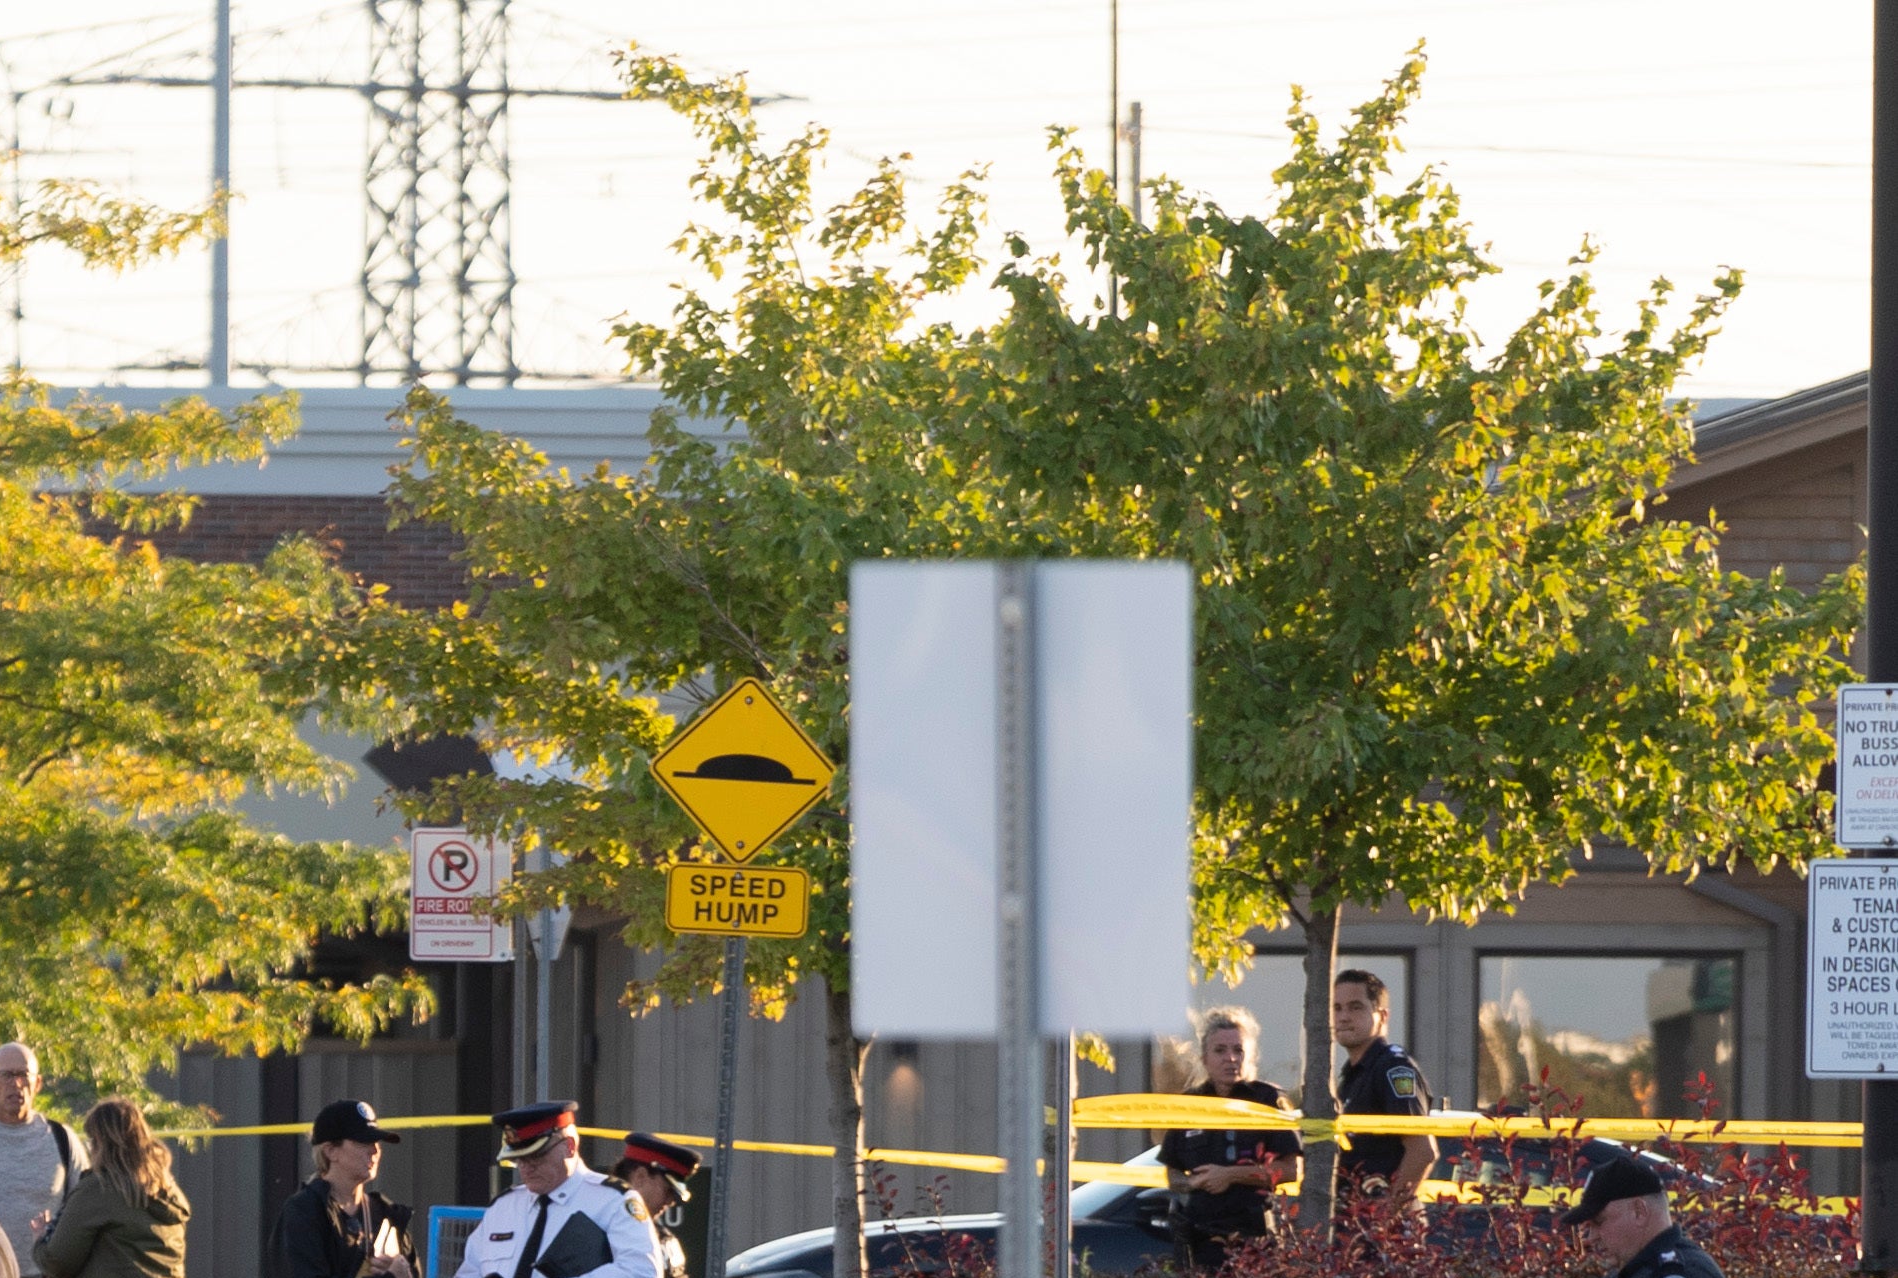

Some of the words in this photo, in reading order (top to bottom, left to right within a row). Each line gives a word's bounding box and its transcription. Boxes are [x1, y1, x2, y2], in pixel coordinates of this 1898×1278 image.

[1845, 703, 1882, 712] PRIVATE
[1845, 721, 1867, 733] NO
[1856, 789, 1872, 800] ON
[690, 874, 786, 899] SPEED
[1819, 876, 1875, 890] PRIVATE
[416, 899, 444, 912] FIRE
[694, 901, 779, 924] HUMP
[1832, 917, 1842, 933] &
[1822, 957, 1838, 972] IN
[1827, 976, 1891, 992] SPACES
[1830, 1001, 1839, 1015] 3
[1844, 1002, 1888, 1015] HOUR
